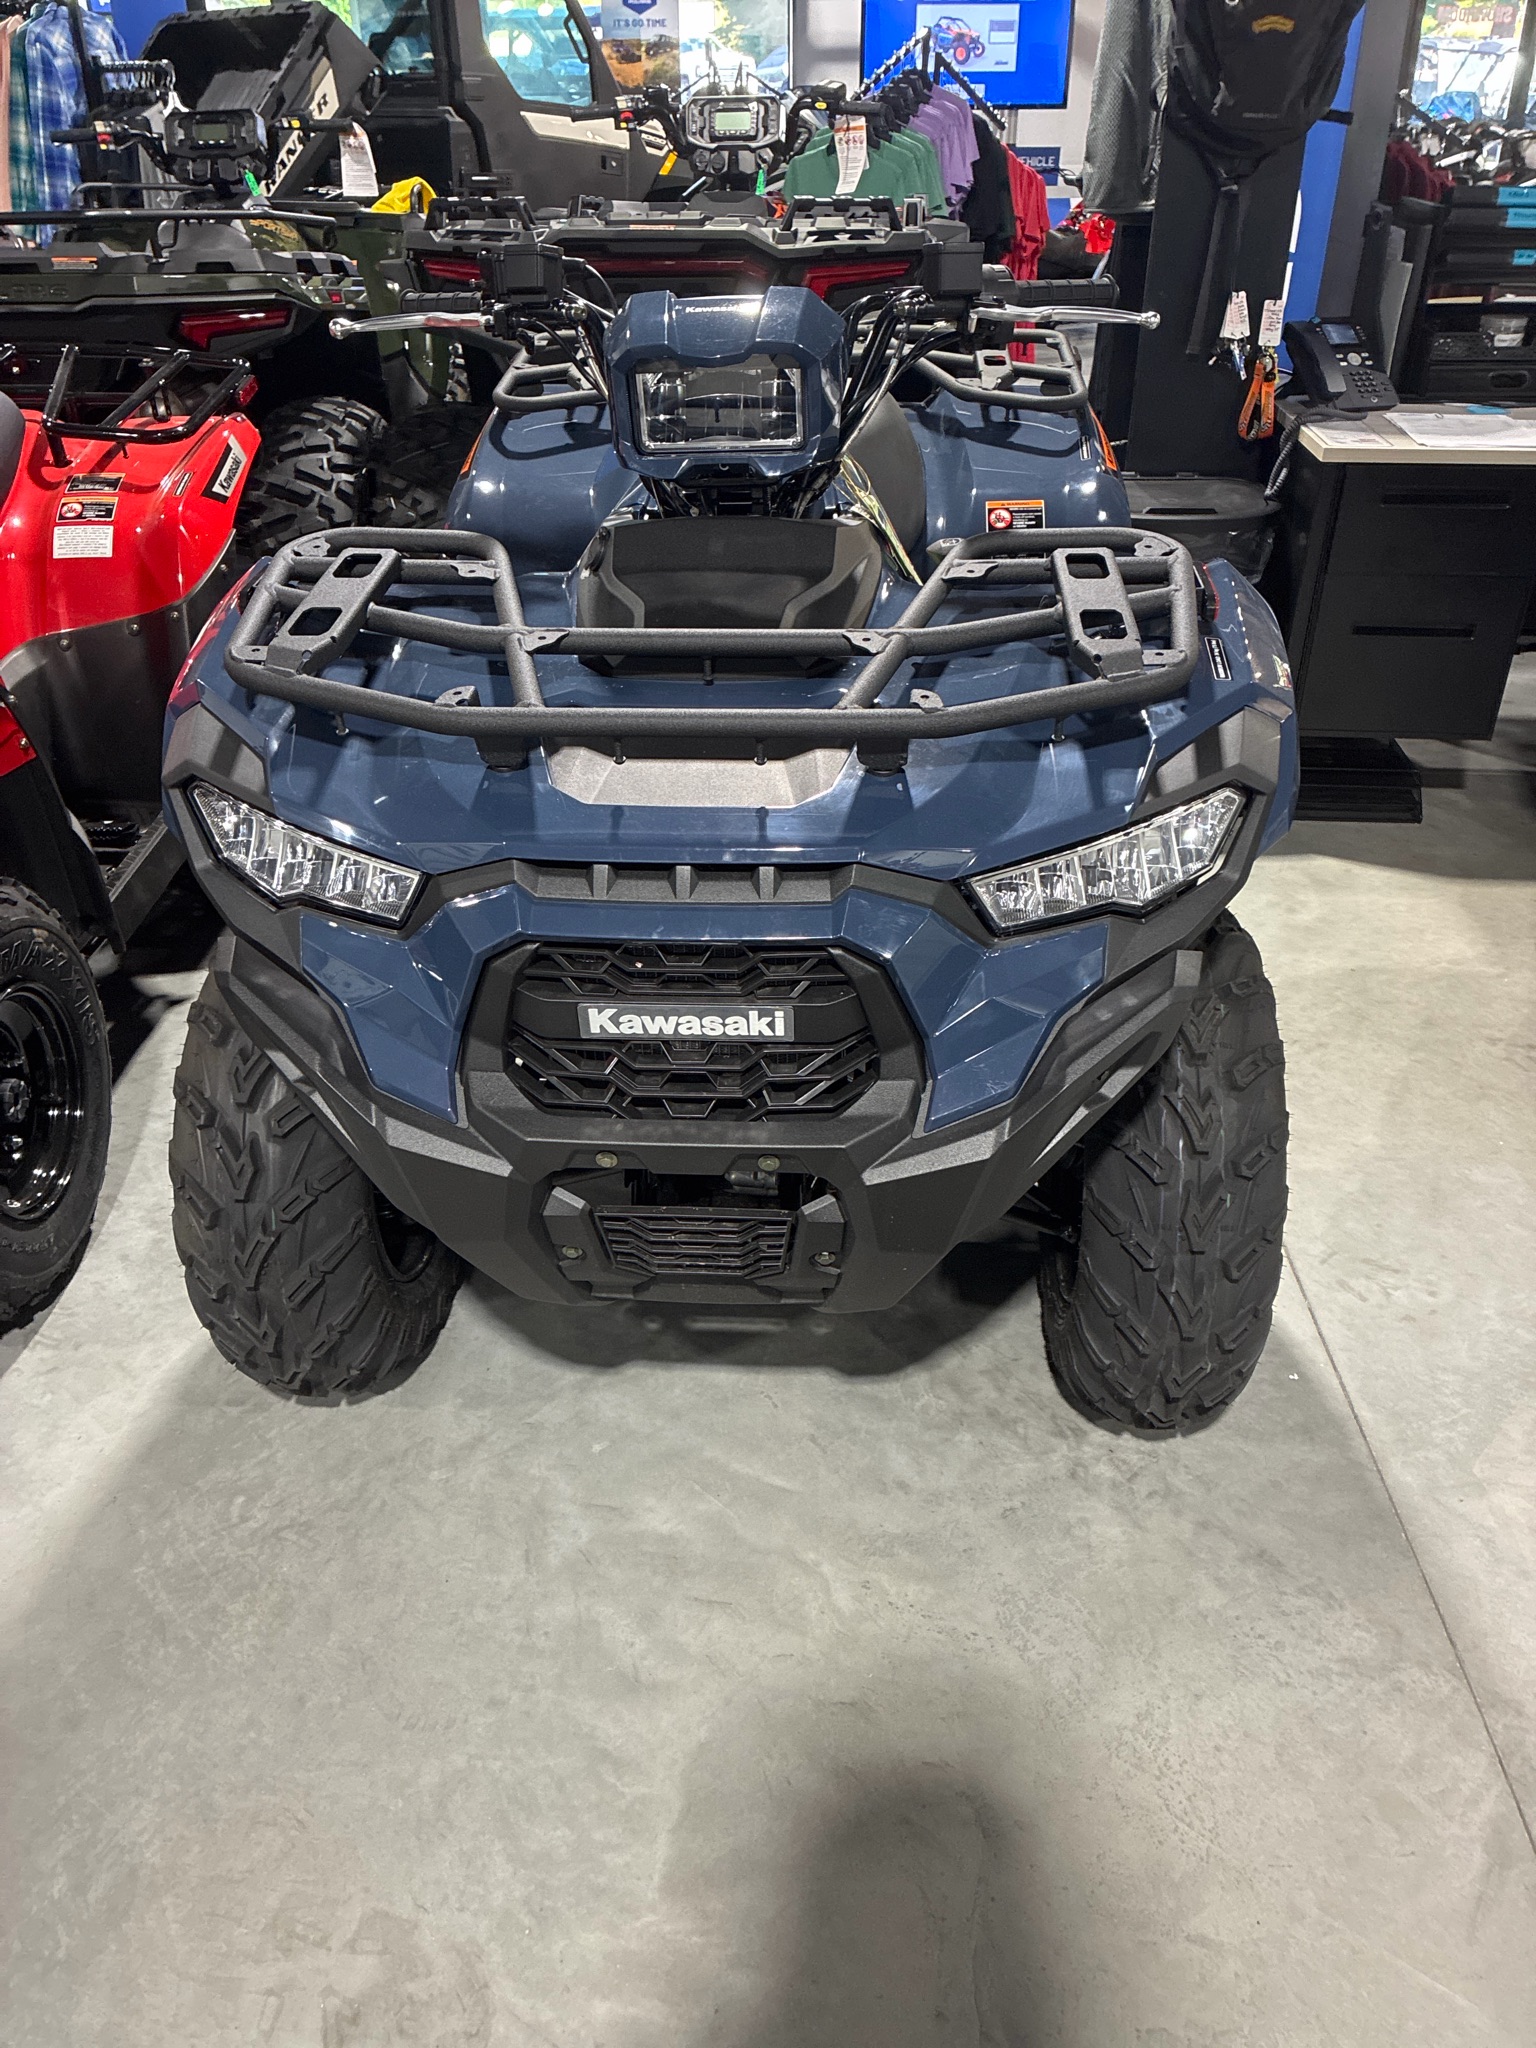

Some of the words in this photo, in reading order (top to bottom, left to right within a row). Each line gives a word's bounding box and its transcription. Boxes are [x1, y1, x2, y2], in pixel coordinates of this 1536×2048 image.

[613, 18, 630, 28] IT'S
[631, 18, 644, 28] GO
[646, 18, 667, 28] TIME
[217, 452, 243, 494] Kawasaki
[588, 1008, 785, 1036] Kawasaki
